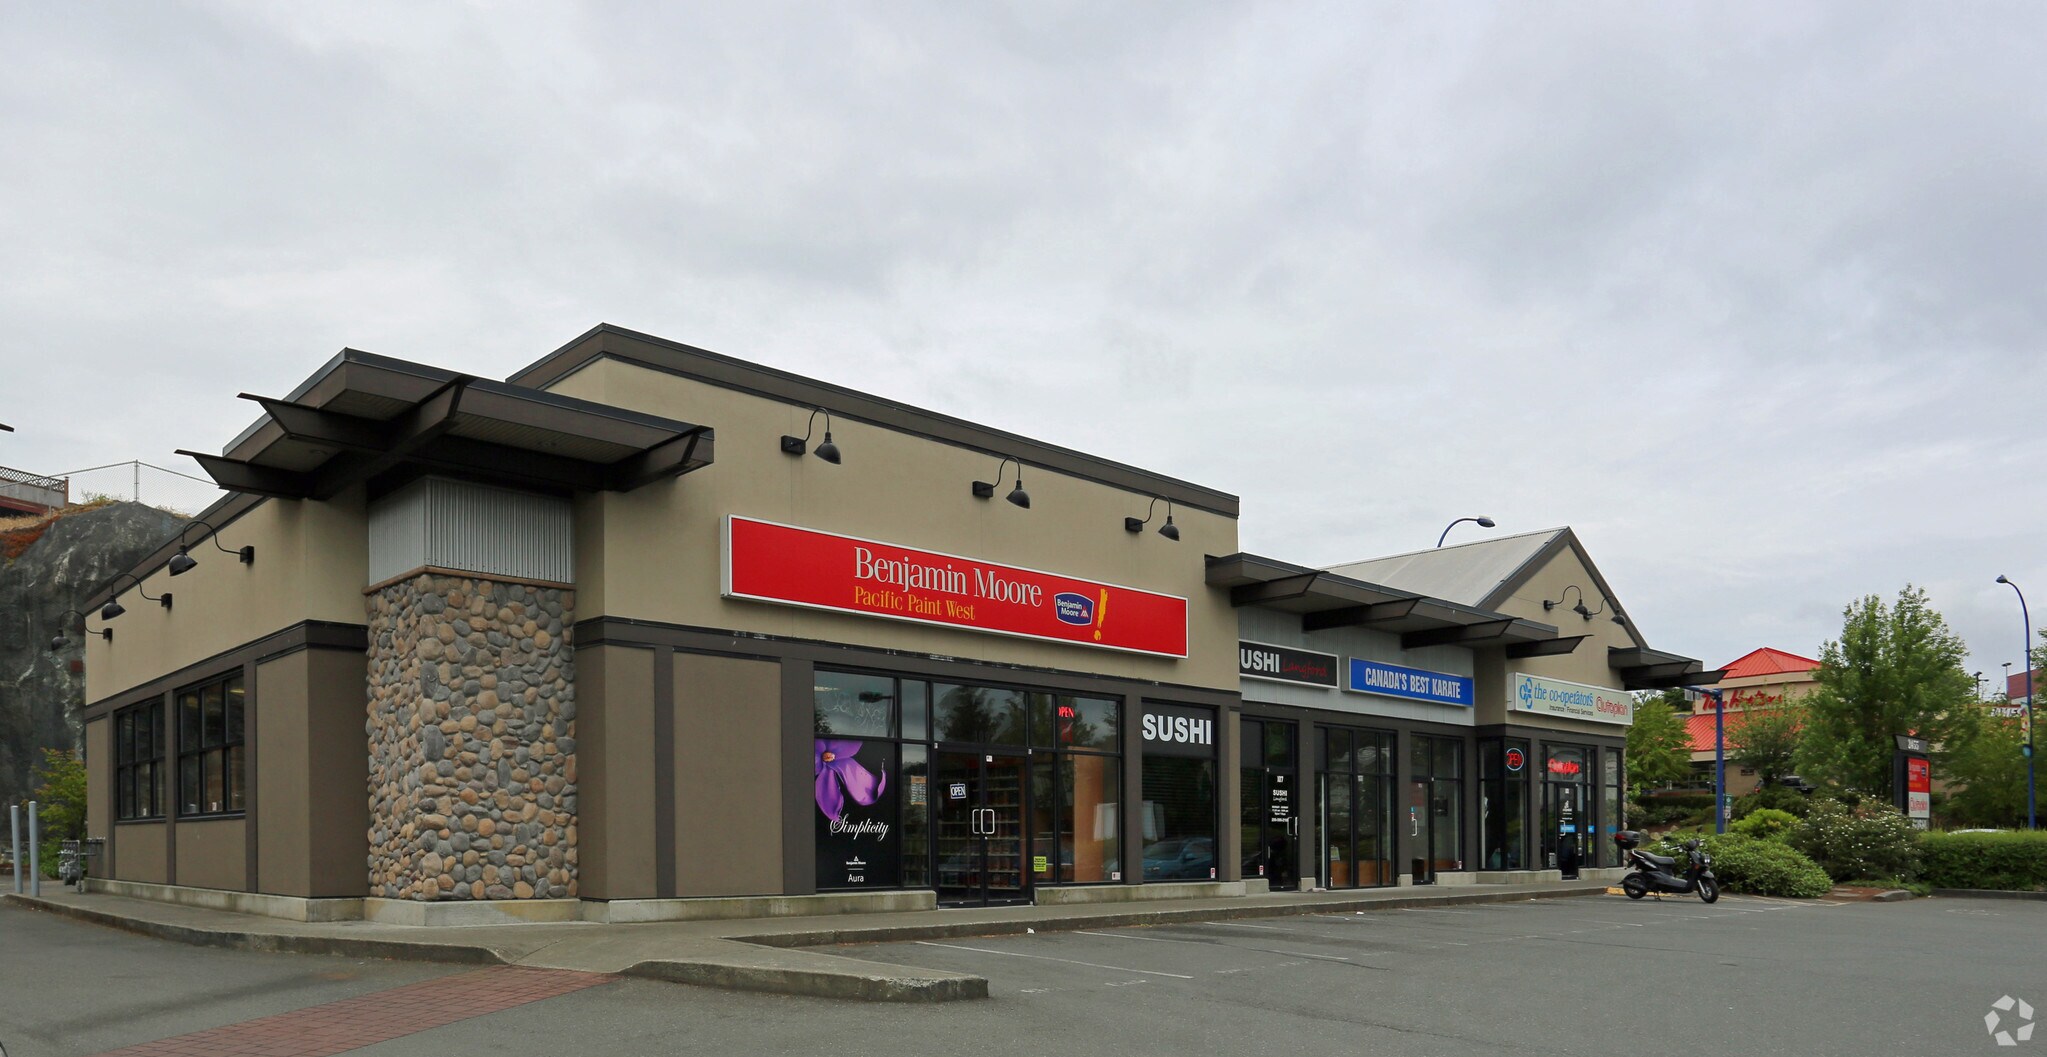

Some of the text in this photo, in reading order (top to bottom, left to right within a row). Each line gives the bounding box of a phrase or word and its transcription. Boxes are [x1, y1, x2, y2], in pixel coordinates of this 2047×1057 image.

[854, 546, 1043, 608] Benjamin Moore
[854, 586, 976, 621] Pacific Paint West
[1056, 598, 1083, 613] Benjamin
[1061, 608, 1080, 618] Moore
[1239, 648, 1280, 673] USHI
[1365, 667, 1461, 699] CANADA'S BEST KARATE
[1534, 682, 1594, 708] the co-operators
[1142, 713, 1212, 745] SUSHI
[830, 813, 889, 842] Simplicity
[847, 873, 865, 883] Aura
